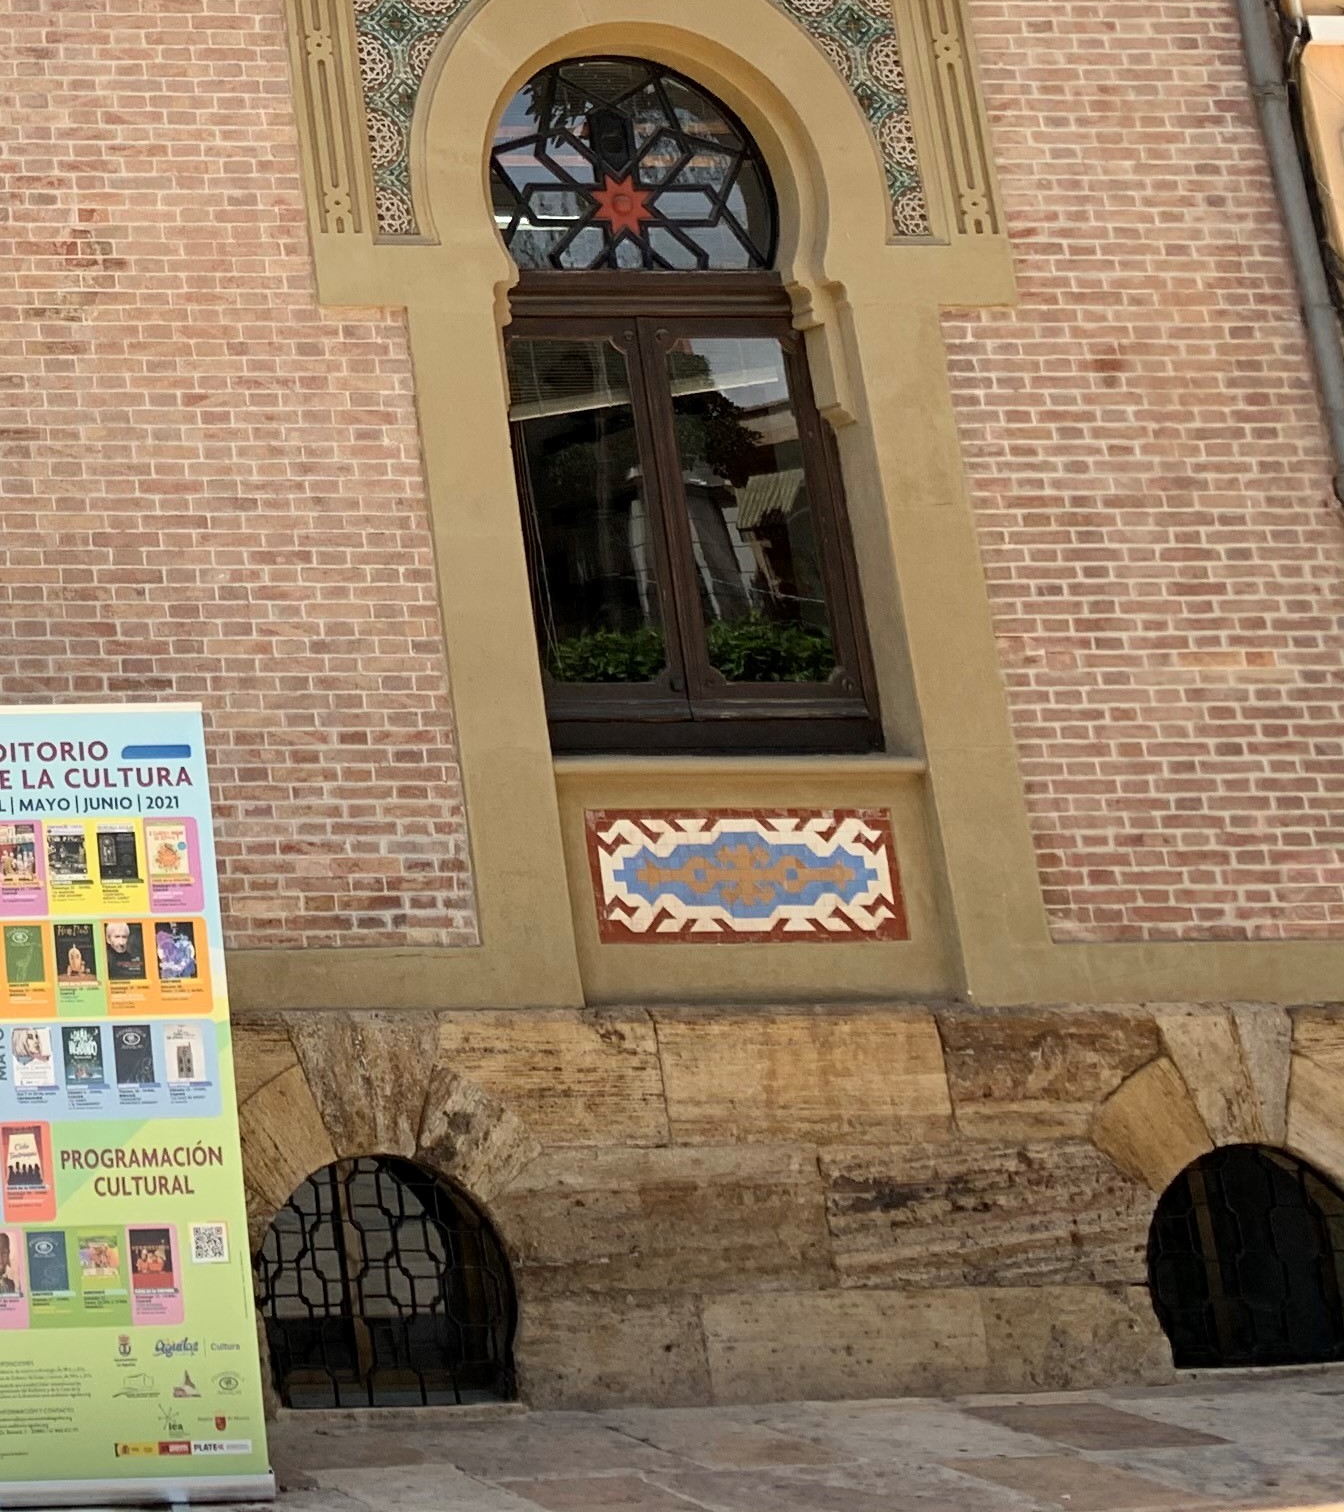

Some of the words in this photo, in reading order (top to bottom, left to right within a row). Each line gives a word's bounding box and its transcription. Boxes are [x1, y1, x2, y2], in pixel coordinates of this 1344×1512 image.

[21, 769, 55, 790] LA
[64, 766, 193, 788] CULTURA
[19, 797, 71, 812] MAYO
[83, 796, 133, 814] JUNIO
[145, 795, 180, 810] 2021
[60, 1140, 223, 1170] PROGRAMACIÓN
[94, 1175, 195, 1197] CULTURAL
